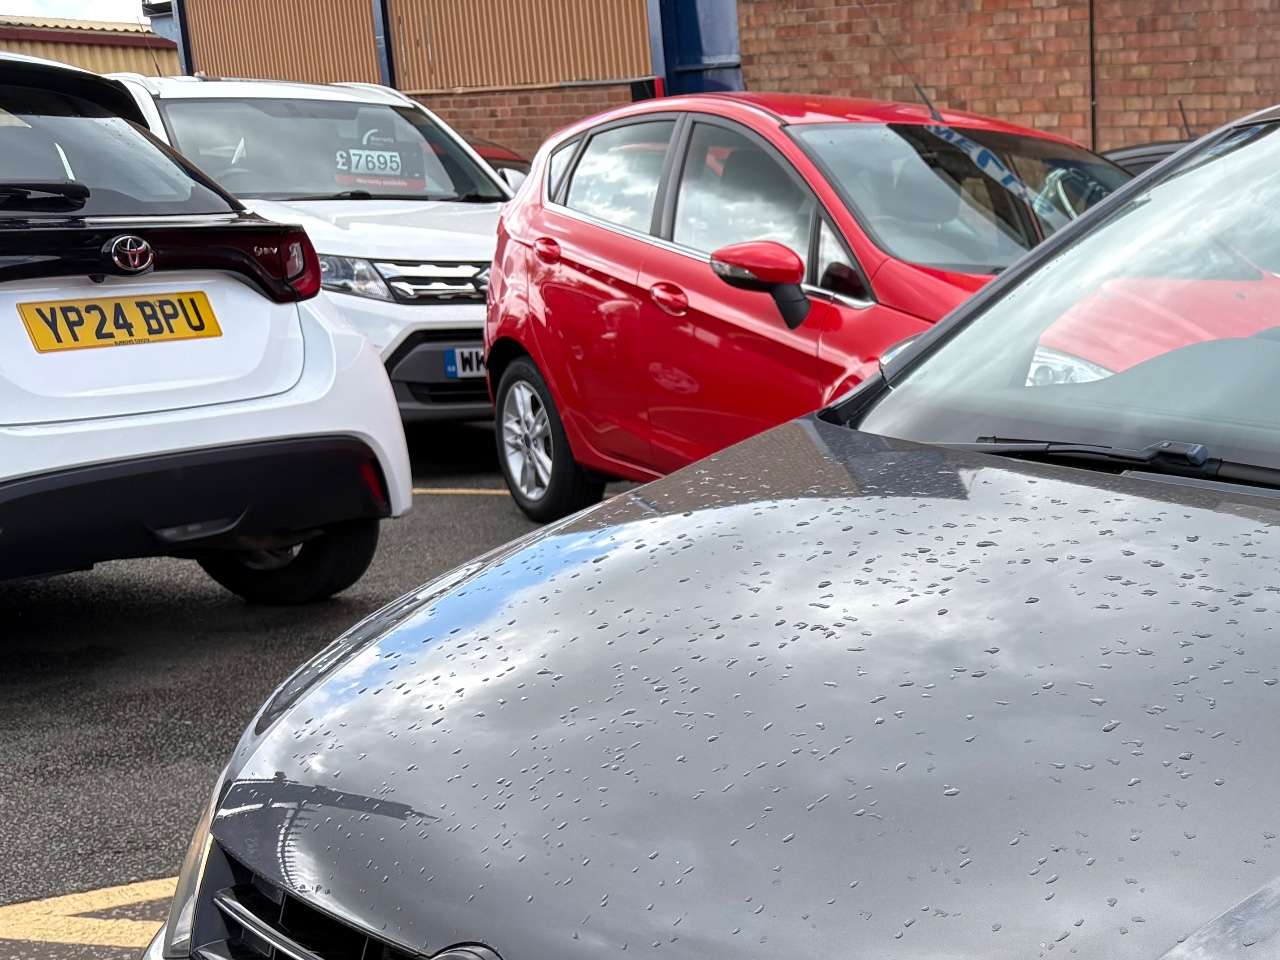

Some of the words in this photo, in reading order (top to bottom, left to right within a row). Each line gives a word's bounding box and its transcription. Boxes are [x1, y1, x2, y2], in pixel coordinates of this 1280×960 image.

[336, 150, 400, 173] £7695
[36, 302, 134, 343] YP24
[135, 298, 206, 335] BPU
